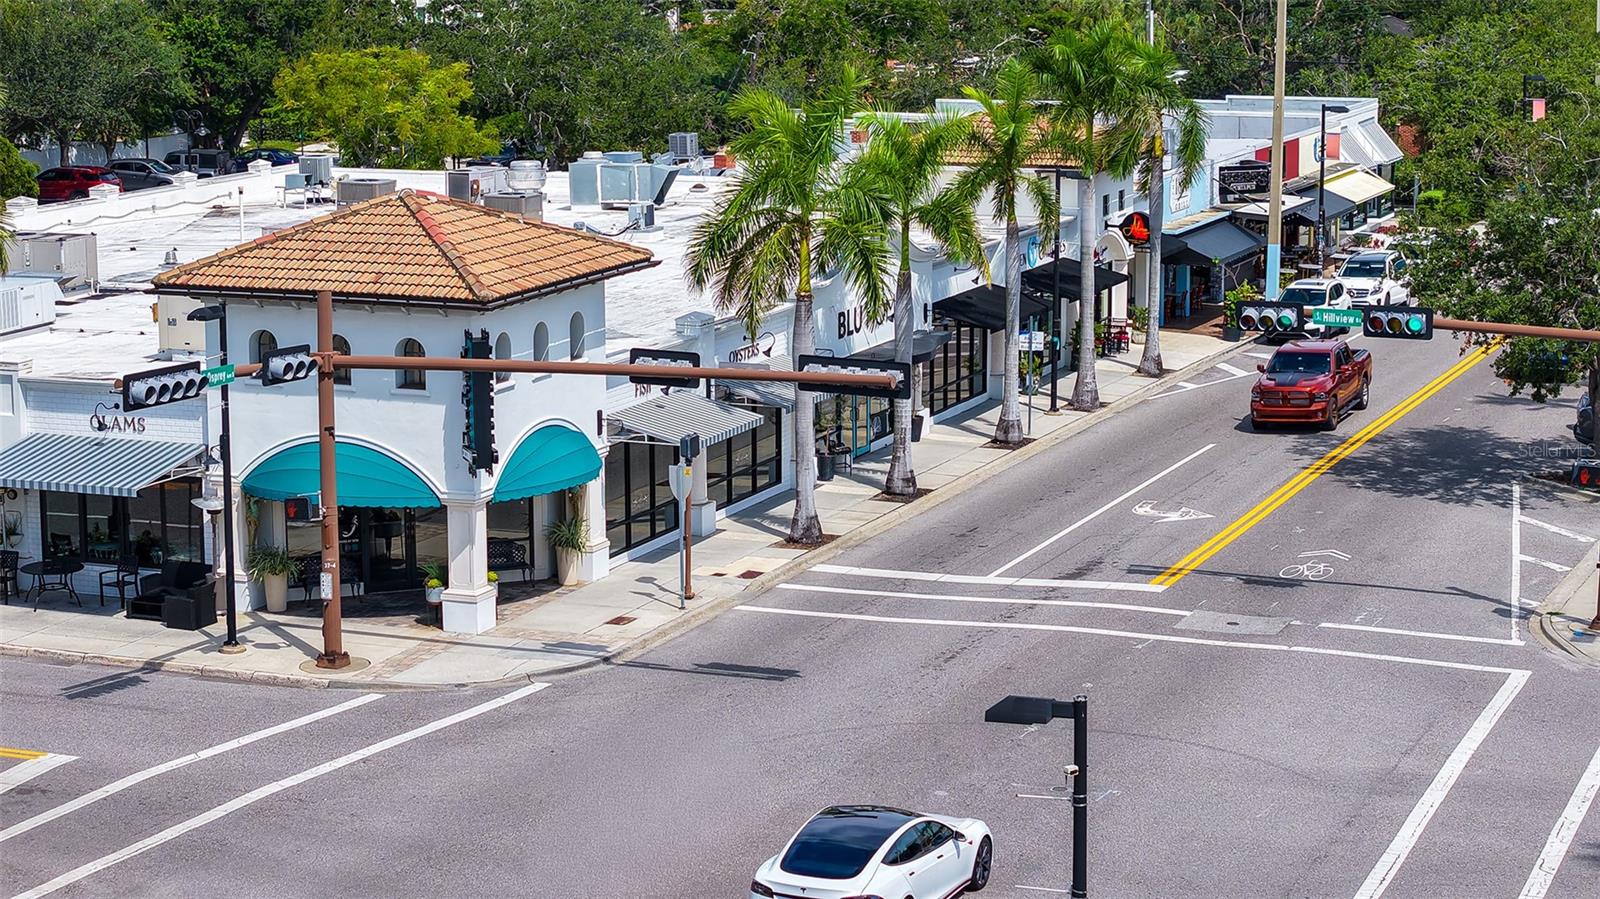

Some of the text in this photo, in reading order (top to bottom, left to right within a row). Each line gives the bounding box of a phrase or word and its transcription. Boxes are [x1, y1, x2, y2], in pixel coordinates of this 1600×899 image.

[838, 305, 863, 340] BLU
[1323, 312, 1355, 324] Hillview
[728, 342, 760, 363] OYSTERS
[207, 371, 226, 384] Osprey
[90, 414, 146, 433] CLAMS
